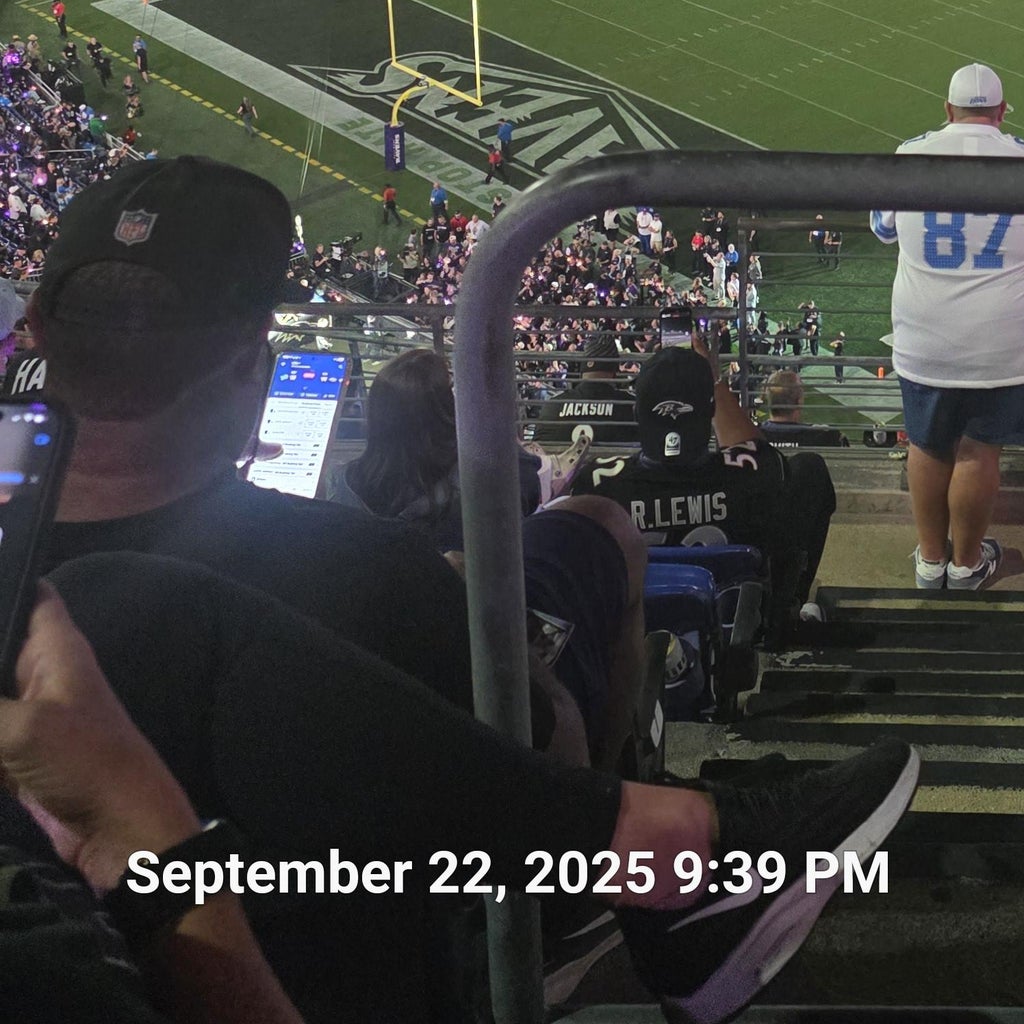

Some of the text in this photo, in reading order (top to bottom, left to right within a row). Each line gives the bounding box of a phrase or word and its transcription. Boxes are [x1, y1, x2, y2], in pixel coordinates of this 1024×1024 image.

[922, 211, 1014, 270] 87
[558, 402, 613, 417] JACKSON
[630, 491, 728, 531] R.LEWIS
